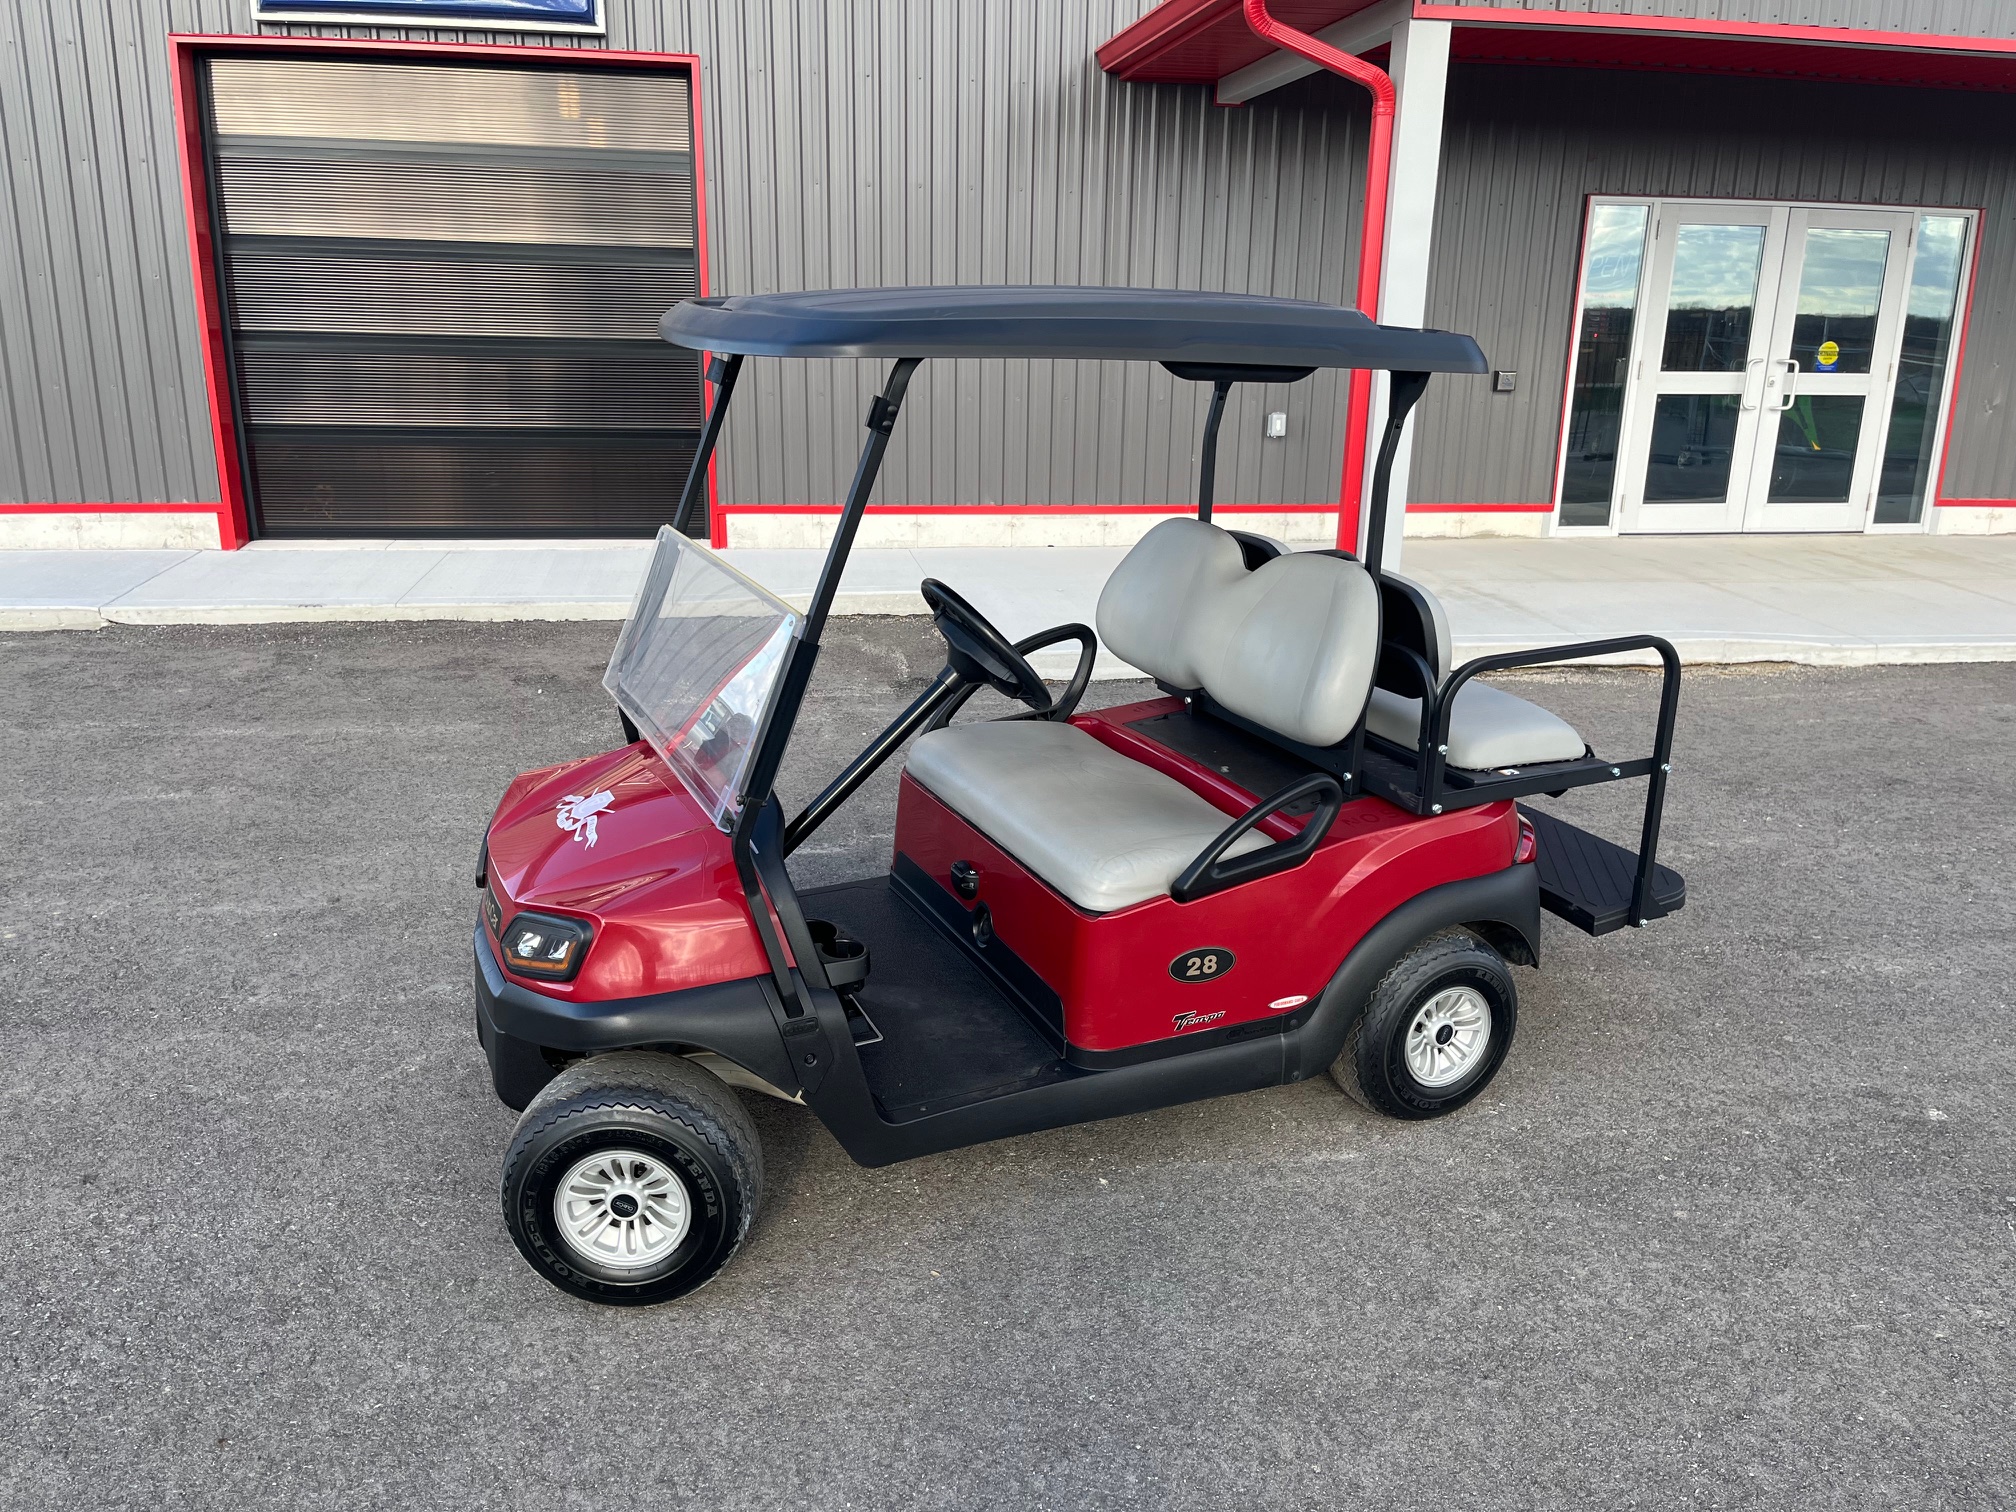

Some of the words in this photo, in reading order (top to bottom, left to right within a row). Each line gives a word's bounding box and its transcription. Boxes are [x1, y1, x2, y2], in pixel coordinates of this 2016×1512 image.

[1588, 254, 1632, 278] PEN
[1185, 954, 1218, 977] 28
[1172, 1010, 1226, 1032] Tempo
[673, 1148, 718, 1219] KENDA
